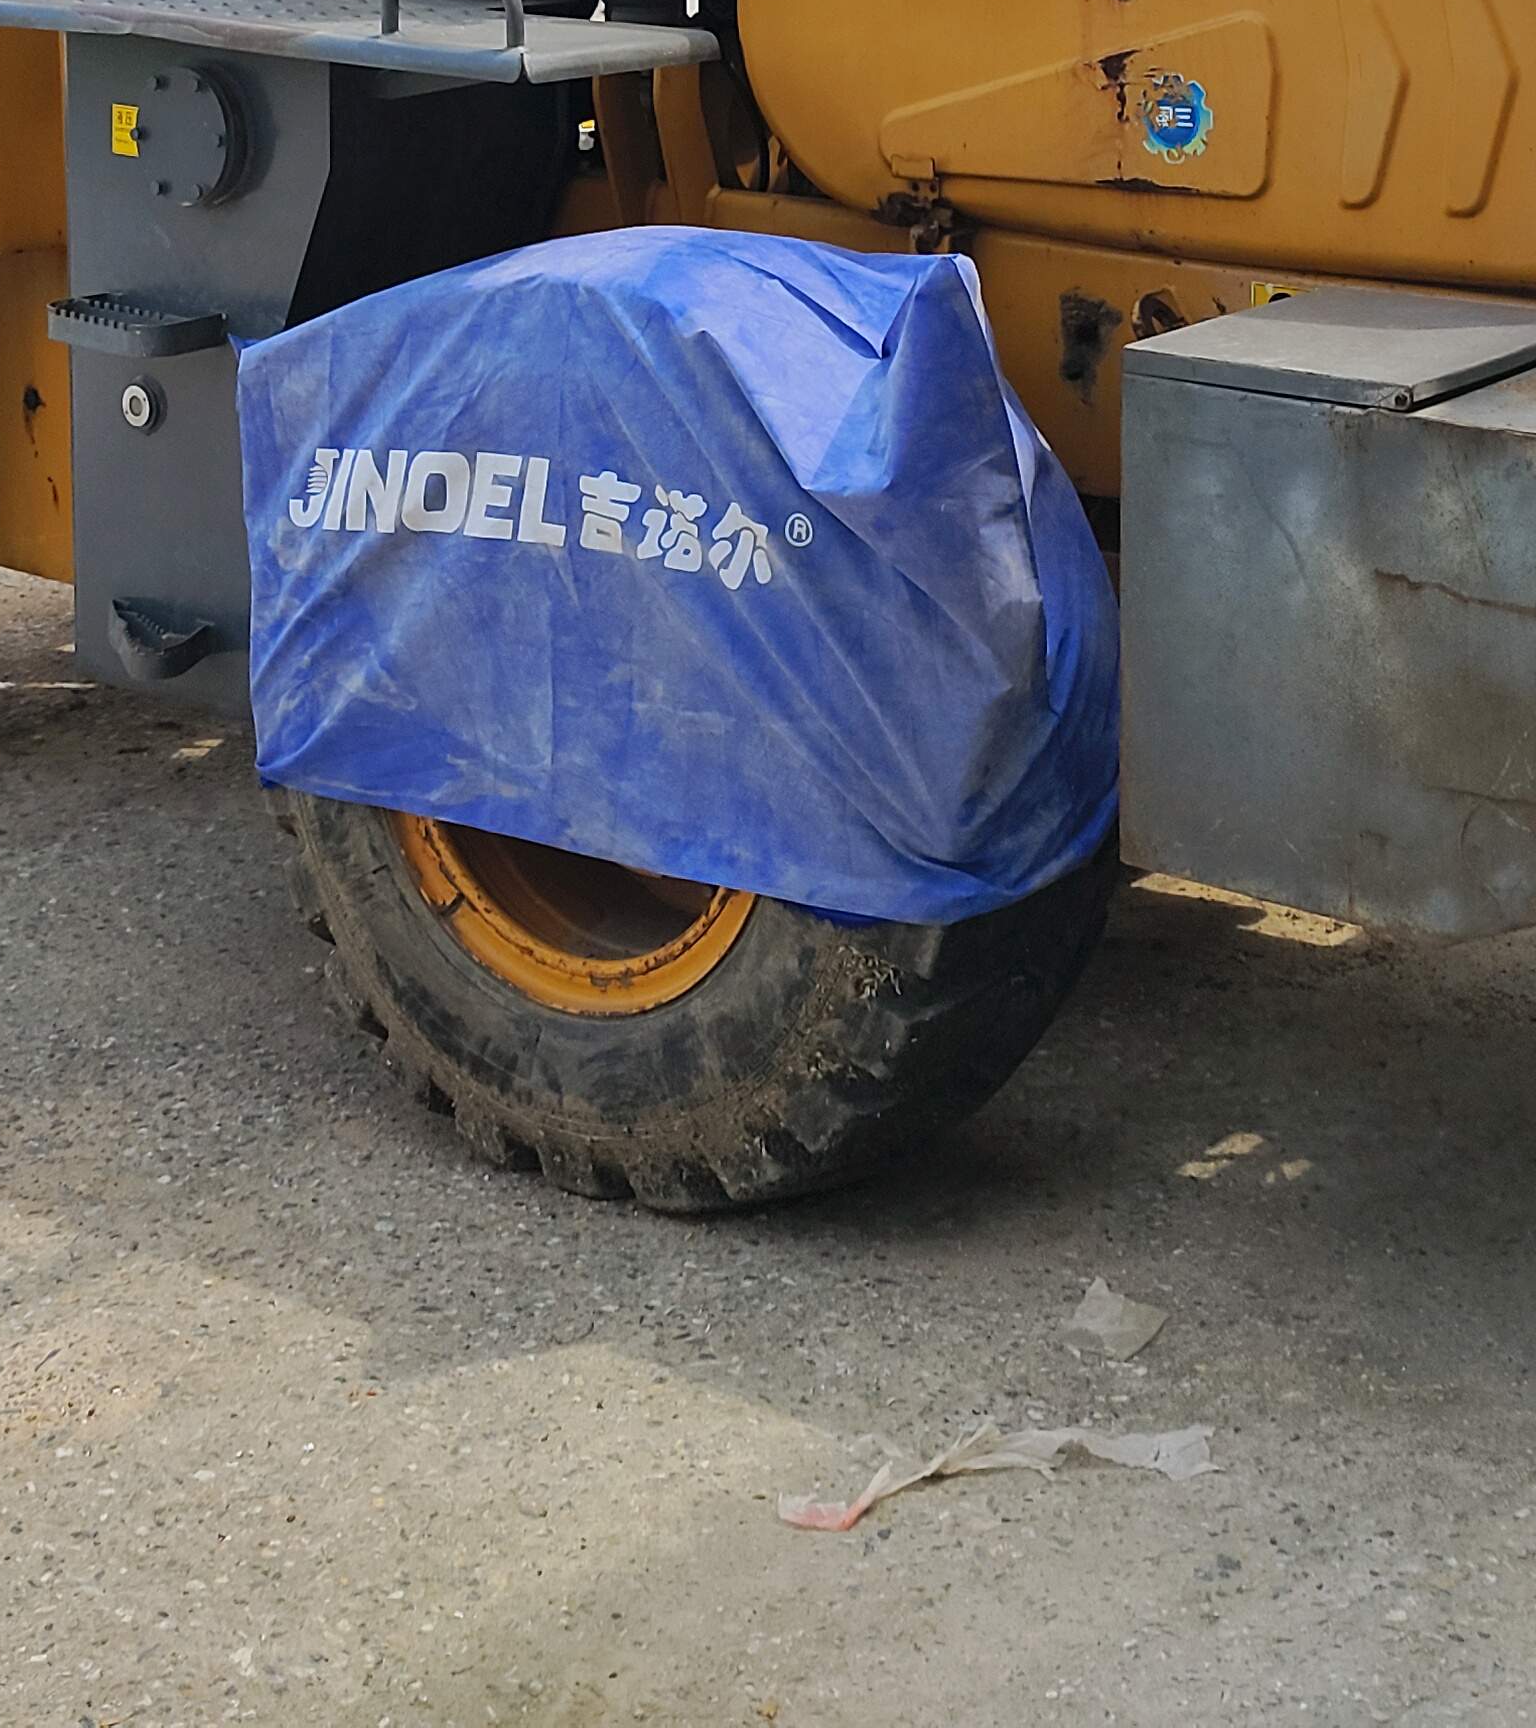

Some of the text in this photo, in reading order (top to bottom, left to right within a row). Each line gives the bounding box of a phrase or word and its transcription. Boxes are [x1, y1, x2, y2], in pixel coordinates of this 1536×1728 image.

[288, 447, 567, 547] JINOEL
[578, 470, 773, 590] 吉诺尔
